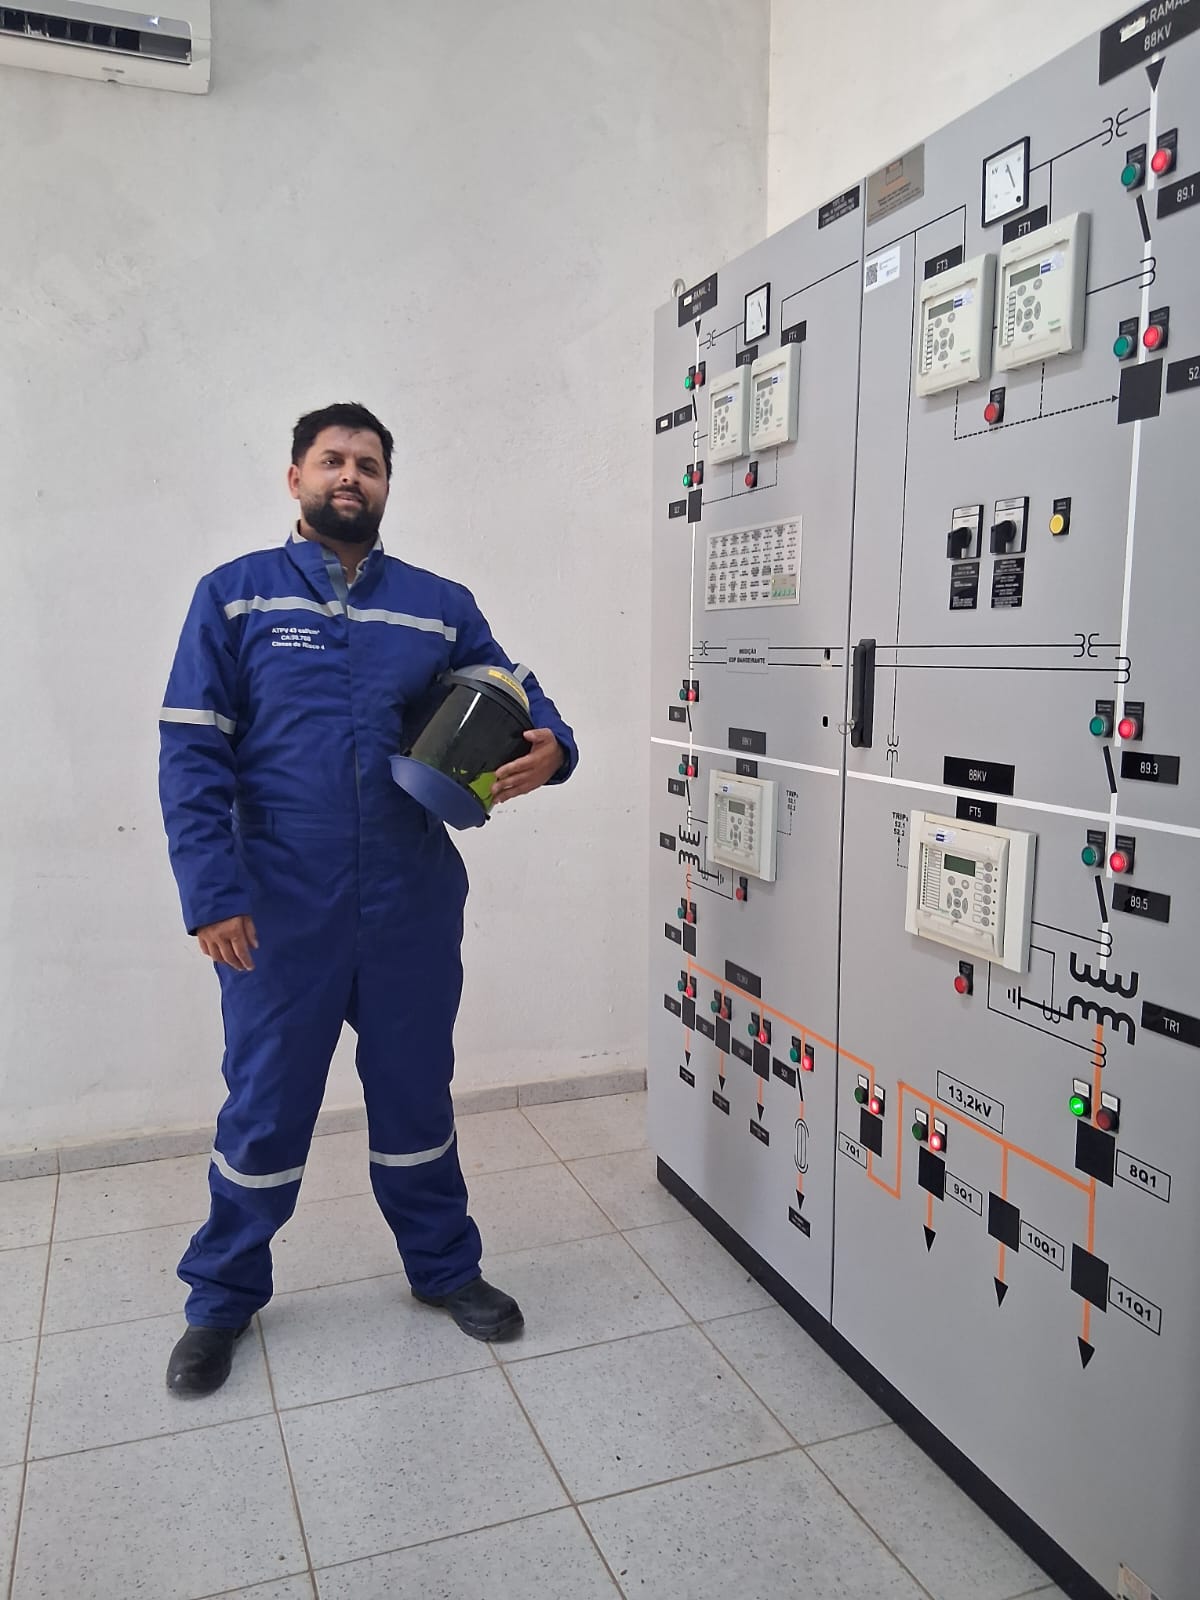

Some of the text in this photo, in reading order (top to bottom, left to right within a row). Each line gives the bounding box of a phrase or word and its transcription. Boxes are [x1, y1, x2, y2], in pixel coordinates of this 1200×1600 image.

[1145, 0, 1191, 25] -RAMA
[1144, 21, 1172, 51] 88KV
[1176, 184, 1194, 203] 89.1
[1018, 221, 1031, 236] FT1
[968, 768, 988, 783] 88KV
[1139, 761, 1159, 776] 89.3
[968, 805, 982, 819] FT5
[1130, 895, 1149, 911] 89.5
[1162, 1017, 1181, 1035] TR1
[948, 1085, 992, 1118] 13,2kV
[845, 1141, 861, 1159] 7Q1
[1129, 1164, 1157, 1188] 8Q1
[953, 1183, 974, 1204] 9Q1
[1027, 1232, 1057, 1259] 10Q1
[1116, 1291, 1152, 1322] 11Q1
